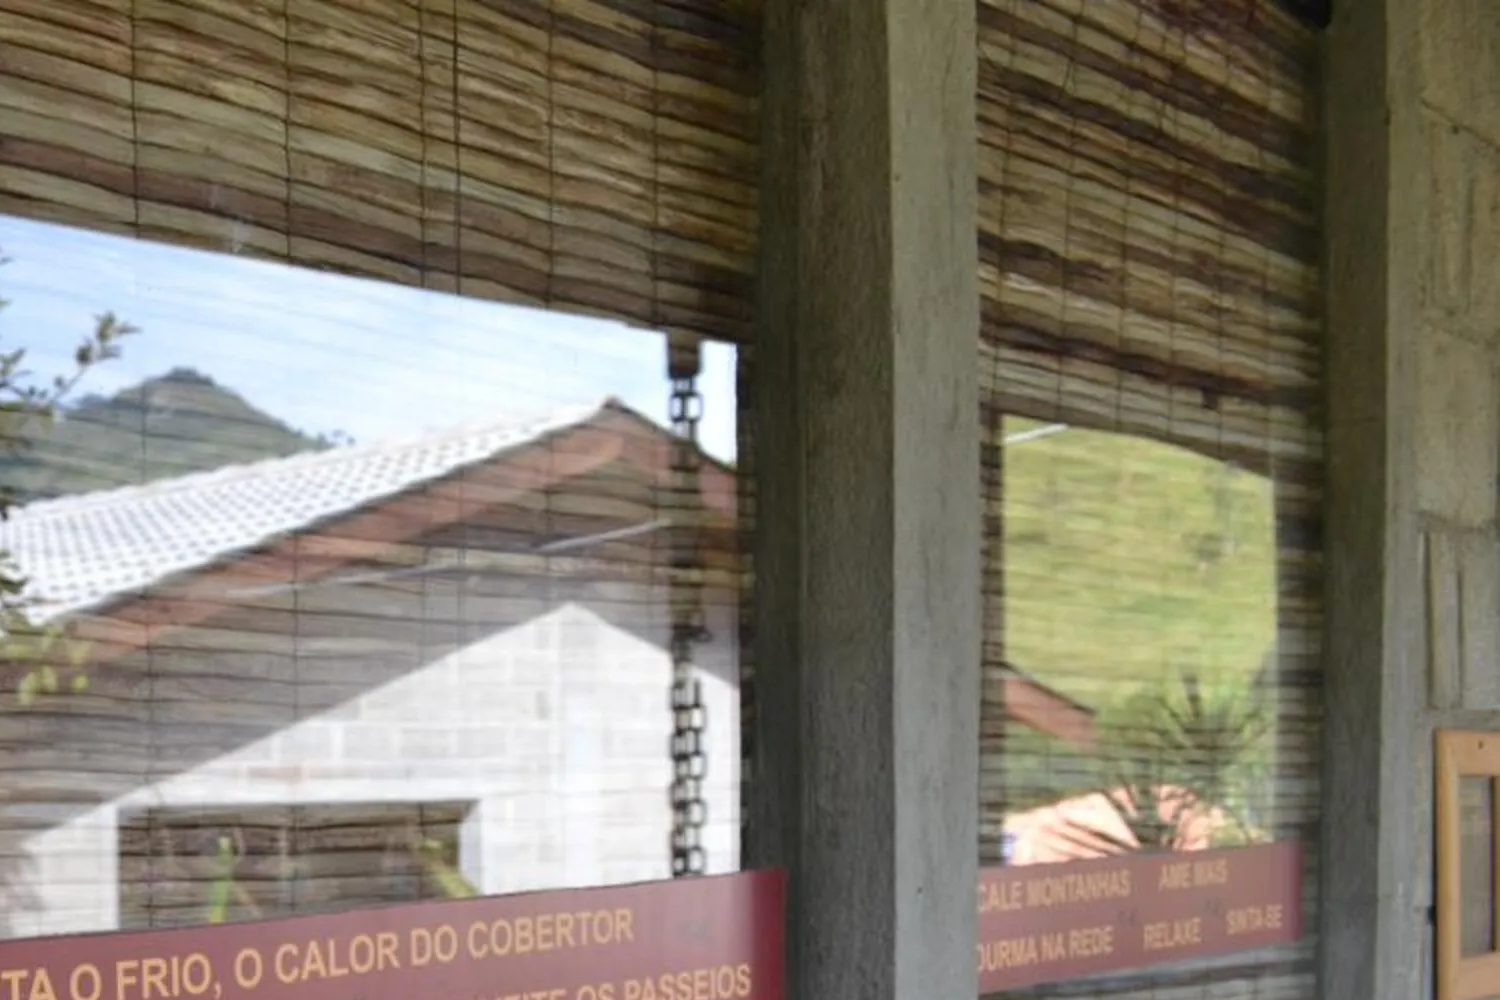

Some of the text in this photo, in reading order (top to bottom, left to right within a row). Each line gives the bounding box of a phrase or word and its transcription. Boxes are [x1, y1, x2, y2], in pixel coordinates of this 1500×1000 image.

[1026, 869, 1132, 908] MONTANHAS
[234, 947, 264, 989] O
[275, 931, 400, 984] CALOR
[410, 924, 458, 967] DO
[467, 907, 635, 960] COBERTOR
[1041, 932, 1066, 963] NA
[1069, 925, 1115, 958] REDE
[1143, 916, 1202, 950] RELAXE
